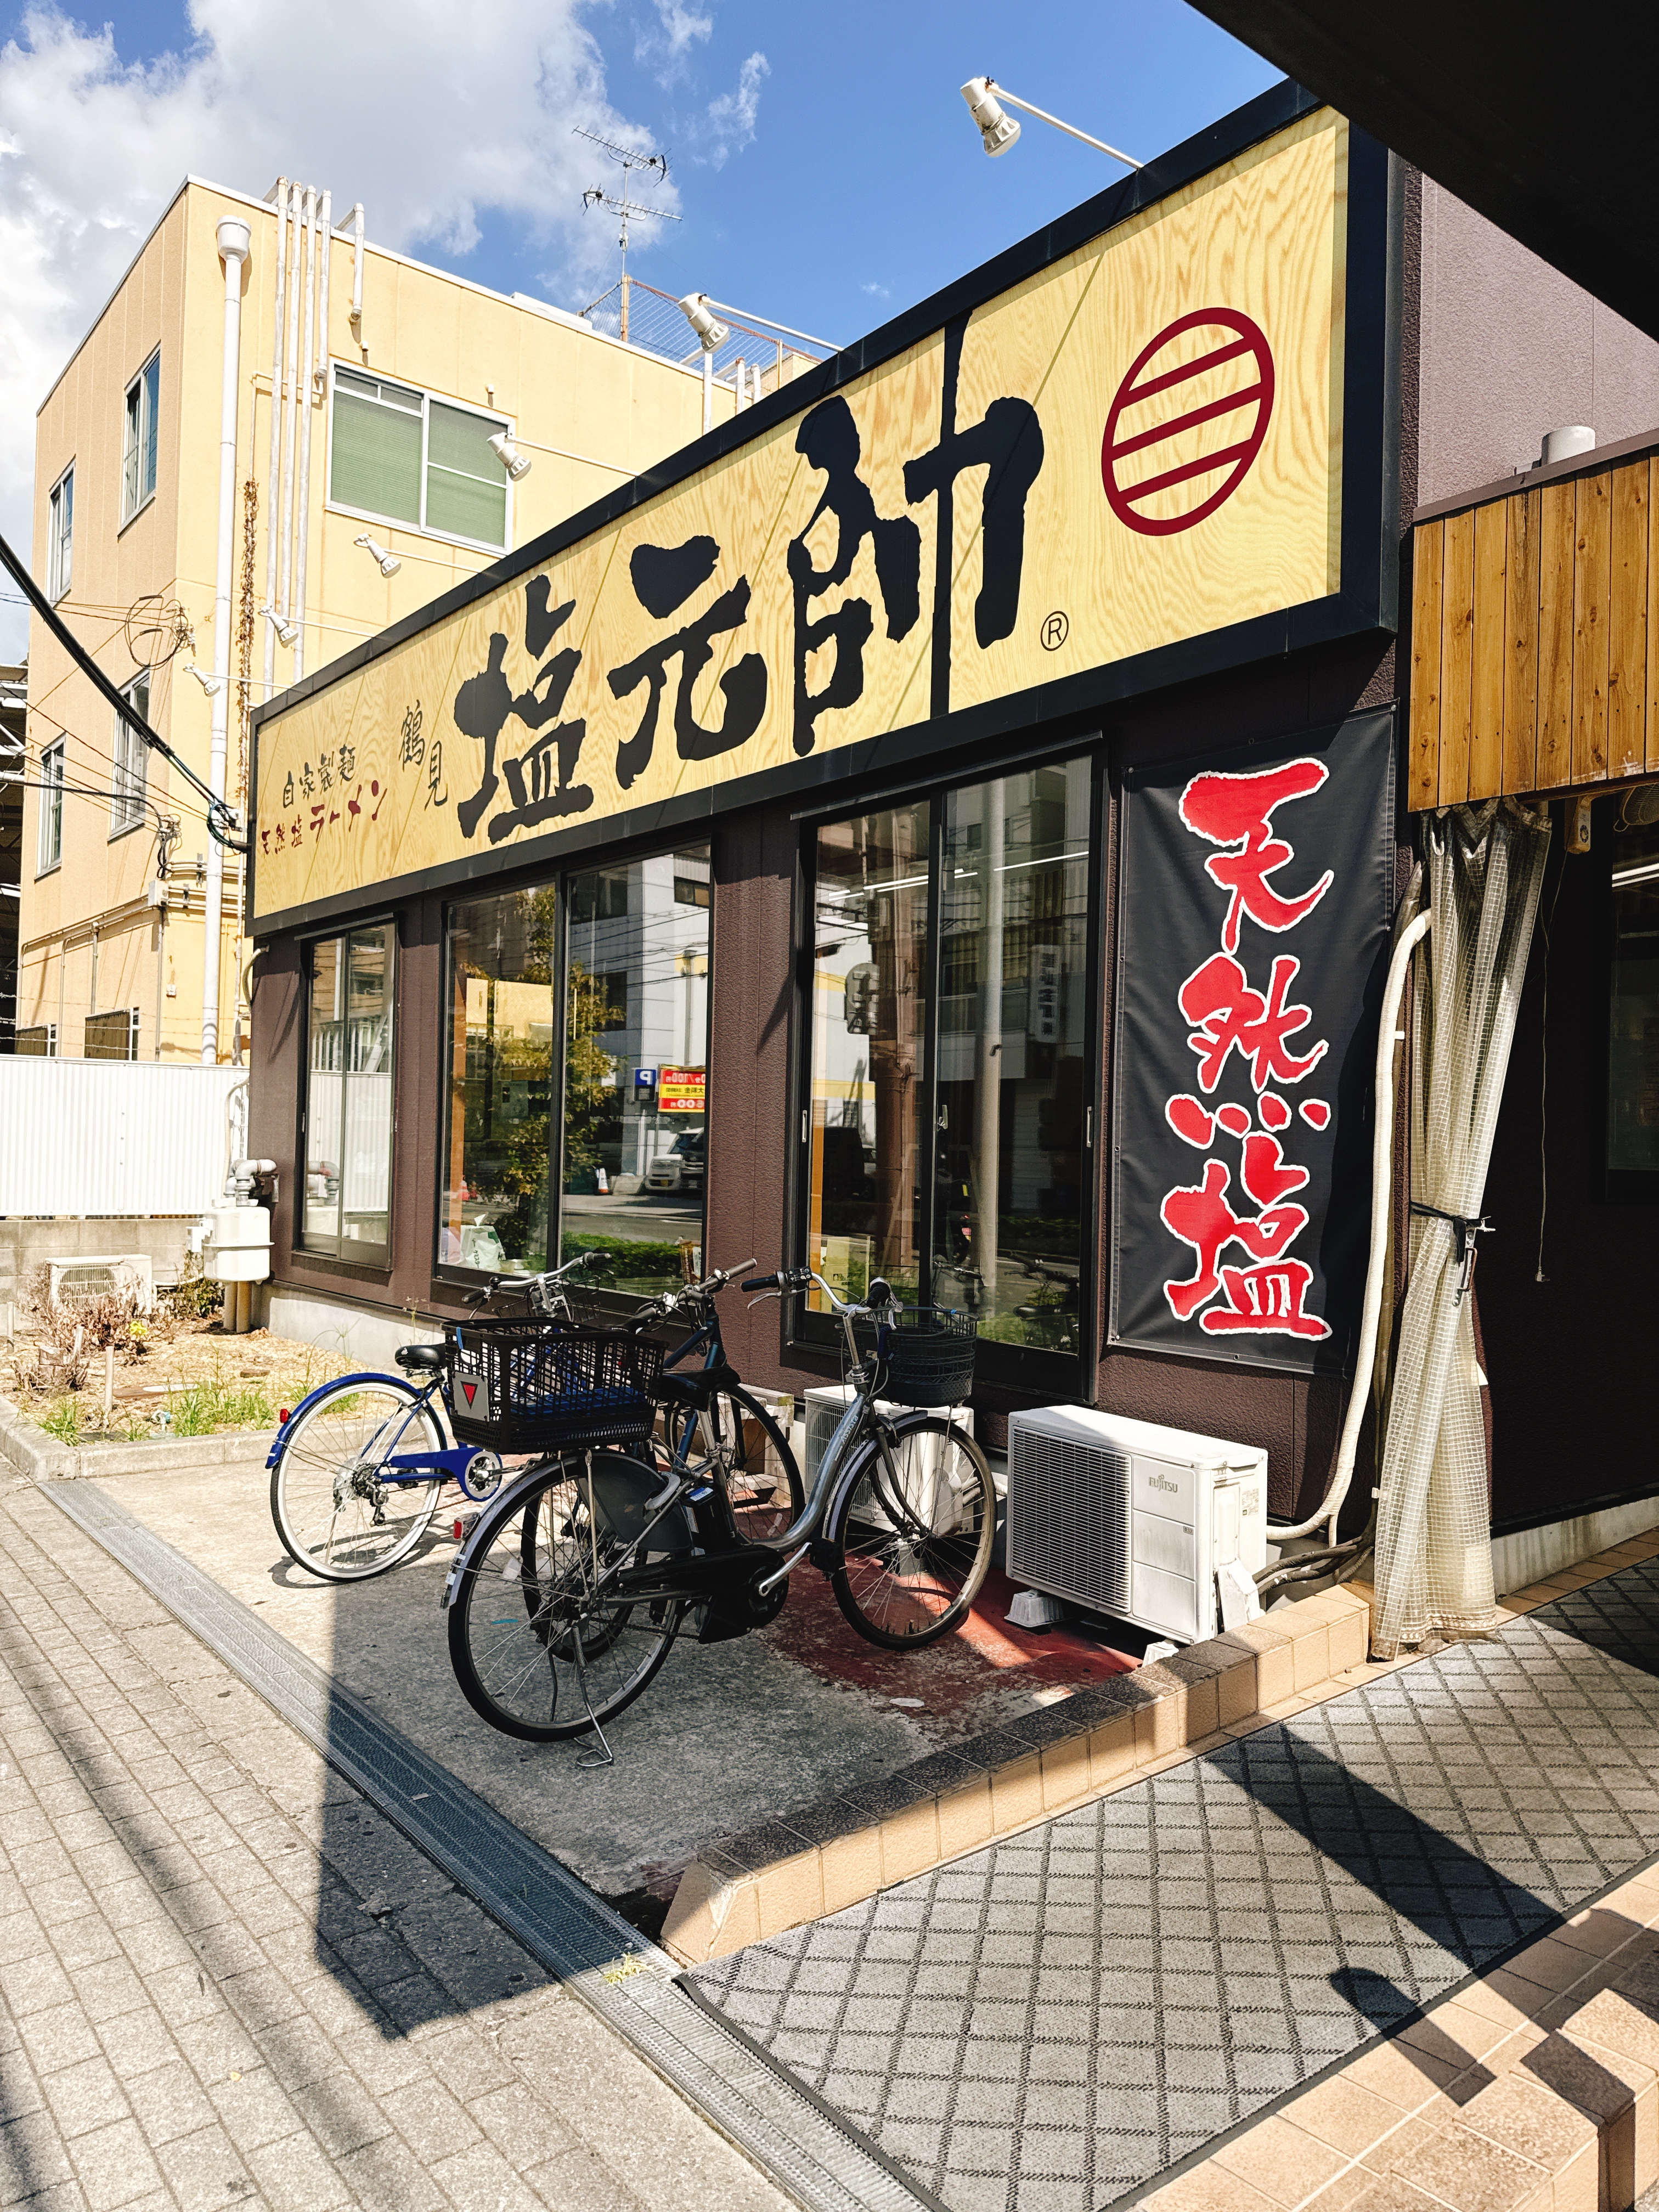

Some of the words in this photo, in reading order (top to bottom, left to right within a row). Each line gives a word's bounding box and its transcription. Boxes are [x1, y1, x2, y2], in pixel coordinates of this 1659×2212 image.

[453, 314, 1043, 845] 塩元帥
[283, 744, 357, 809] 自家製麺
[399, 699, 448, 810] 鶴見
[1160, 758, 1334, 1340] 天然塩
[1149, 1474, 1178, 1493] FUJITSU
